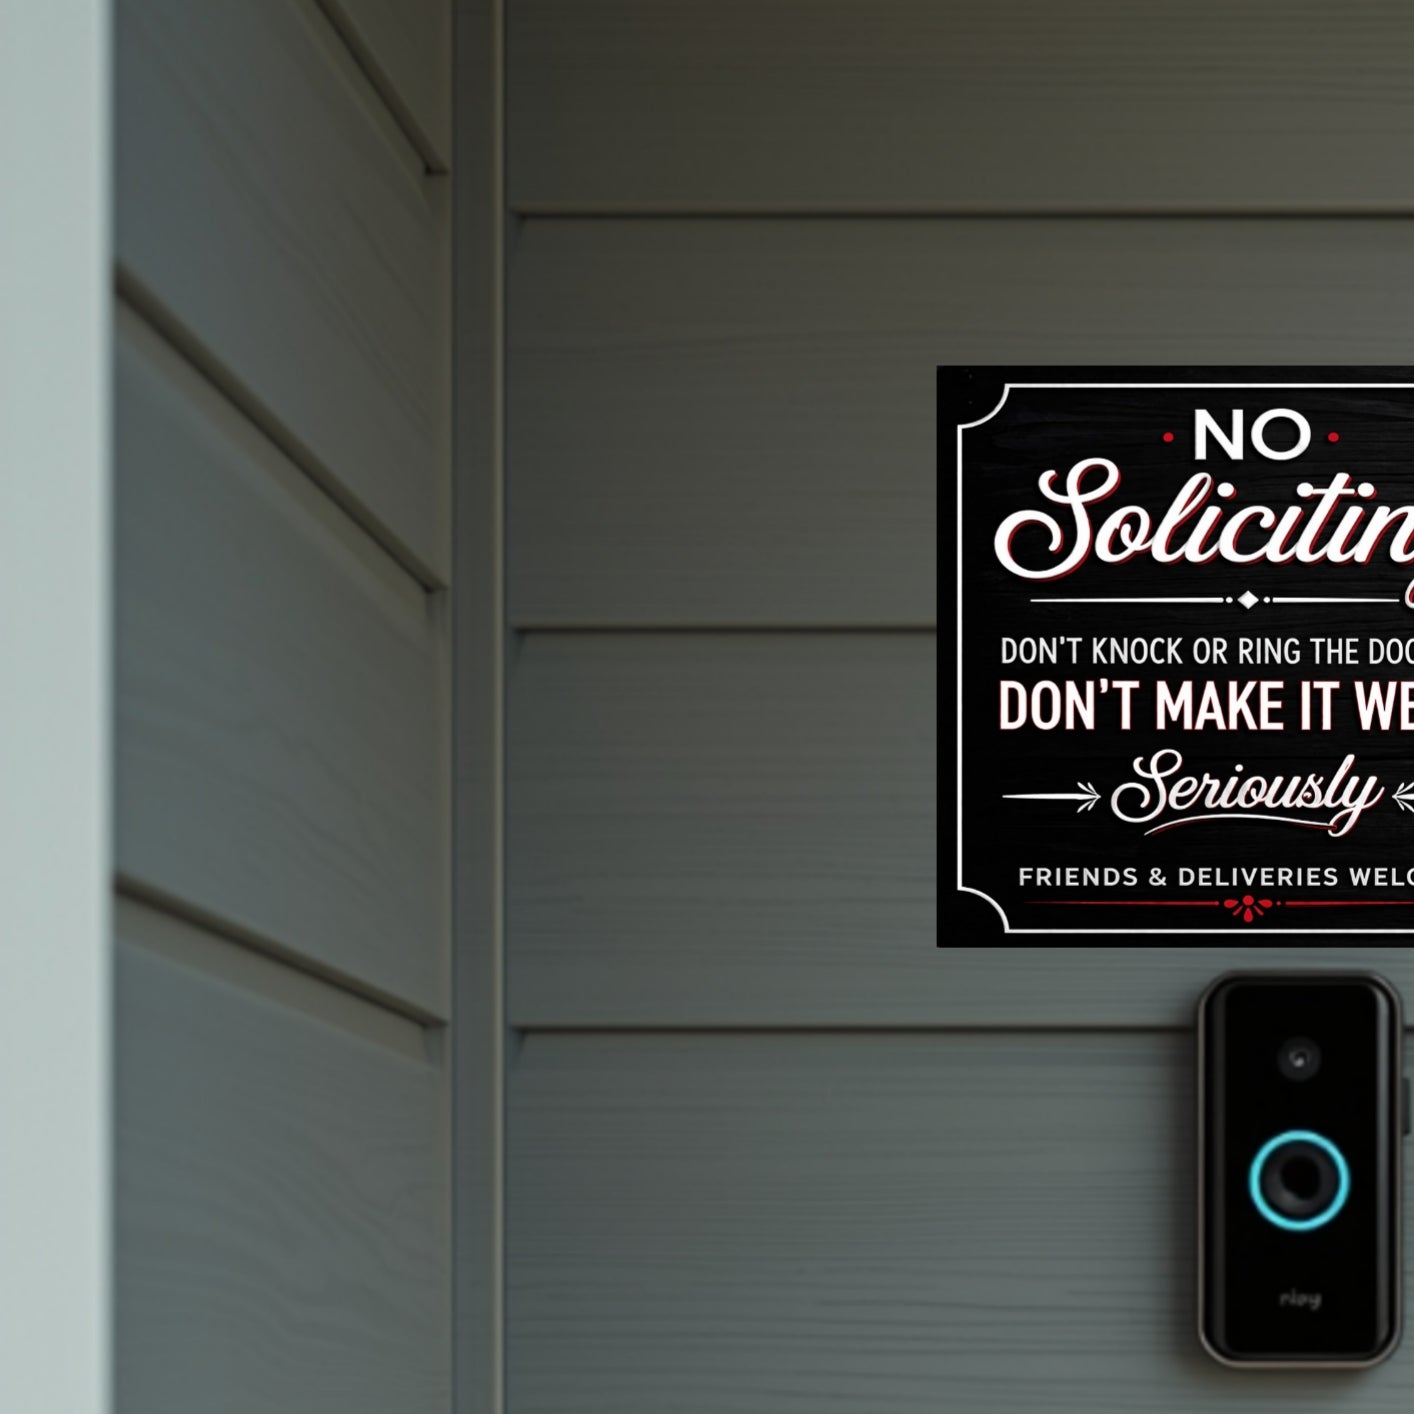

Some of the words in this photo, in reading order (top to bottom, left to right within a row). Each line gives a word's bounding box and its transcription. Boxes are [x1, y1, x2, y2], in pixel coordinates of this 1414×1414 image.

[1194, 407, 1312, 461] NO
[1001, 636, 1083, 664] DON'T
[1092, 637, 1183, 665] KNOCK
[1192, 637, 1228, 665] OR
[1238, 637, 1301, 665] RING
[1309, 637, 1360, 665] THE
[999, 677, 1140, 731] DON'T
[1156, 680, 1285, 731] MAKE
[1301, 680, 1341, 731] IT
[1110, 749, 1385, 837] Seriously
[1019, 867, 1138, 887] FRIENDS
[1148, 867, 1168, 887] &
[1178, 867, 1338, 887] DELIVERIES
